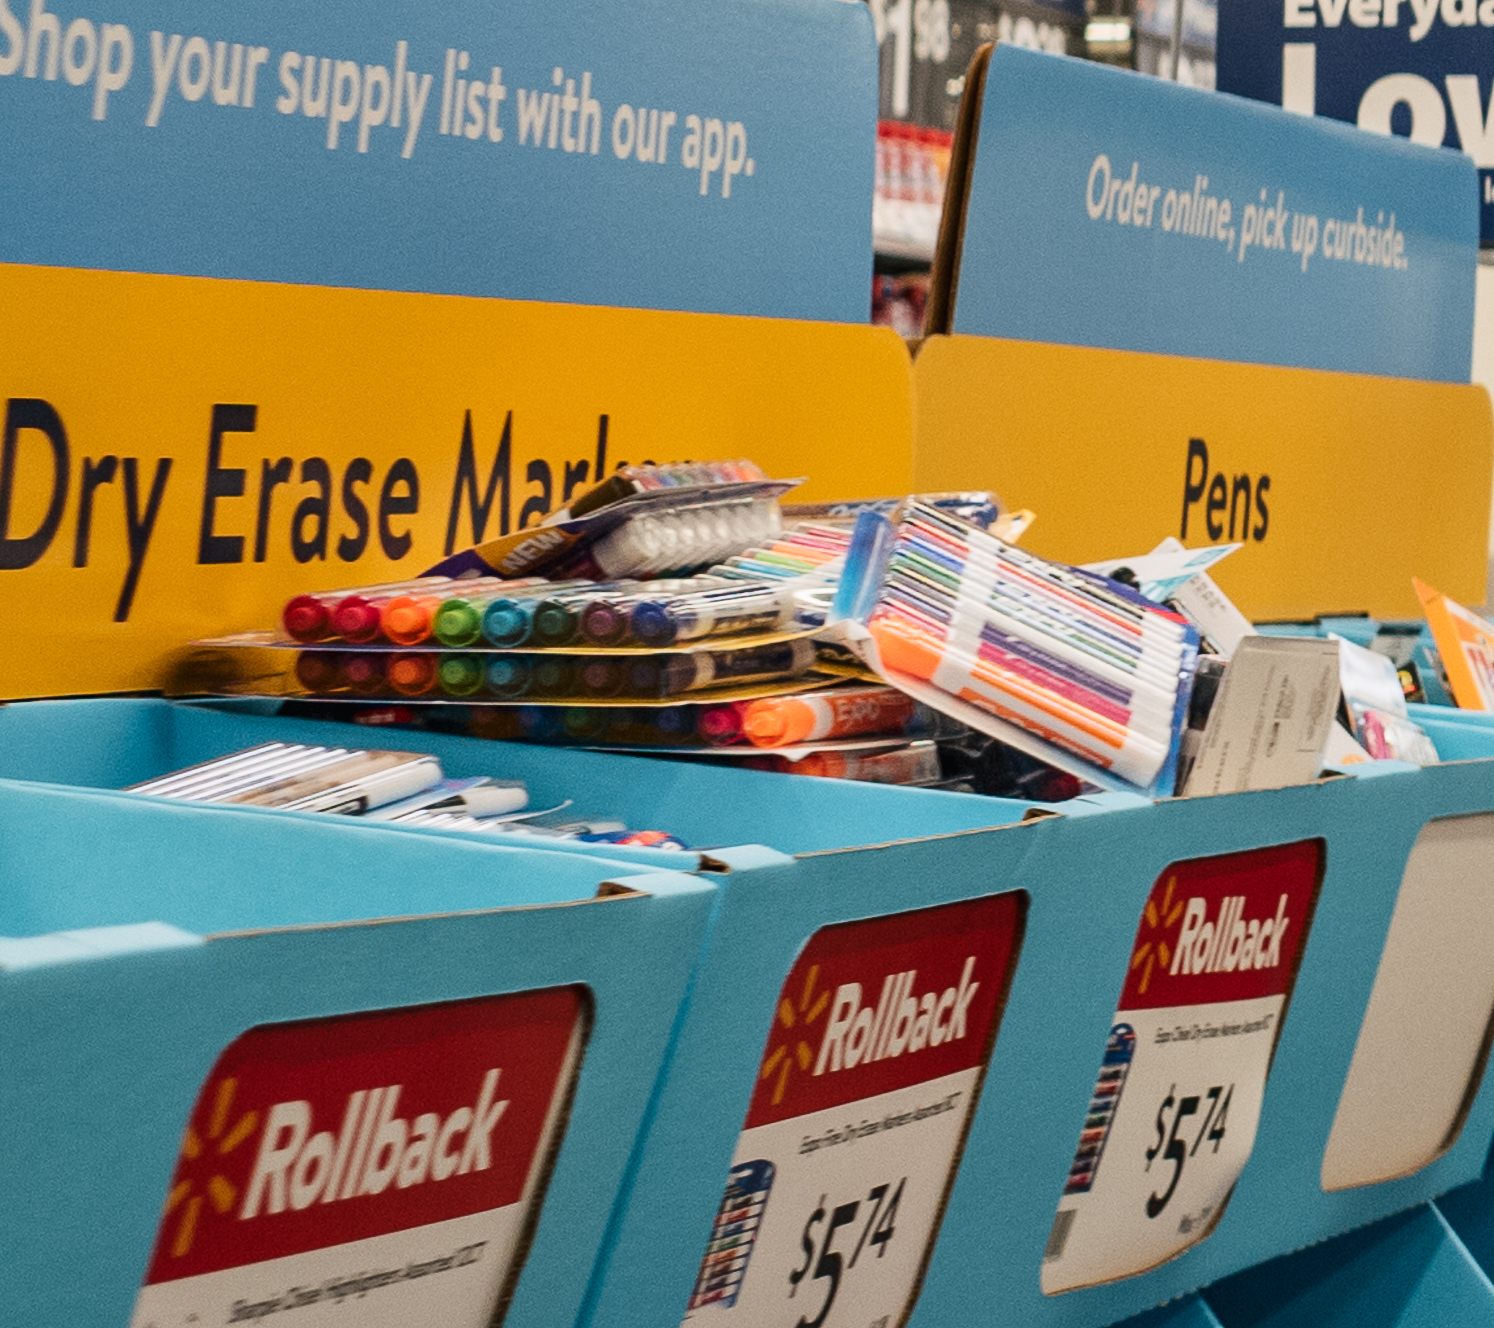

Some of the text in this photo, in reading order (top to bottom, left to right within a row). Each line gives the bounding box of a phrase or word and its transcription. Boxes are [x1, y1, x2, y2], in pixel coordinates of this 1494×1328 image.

[149, 30, 270, 128] your
[278, 39, 433, 159] supply
[439, 48, 506, 143] list
[517, 66, 601, 156] with
[611, 102, 680, 166] our
[681, 114, 756, 199] app.
[1086, 154, 1409, 273] Order online, pick up curbside.
[0, 397, 173, 624] Dry
[196, 403, 421, 566] Erase
[1180, 437, 1272, 542] Pens
[500, 530, 567, 576] NEW
[1168, 893, 1290, 976] Rollback
[812, 955, 980, 1077] Rollback
[238, 1067, 514, 1222] Rollback
